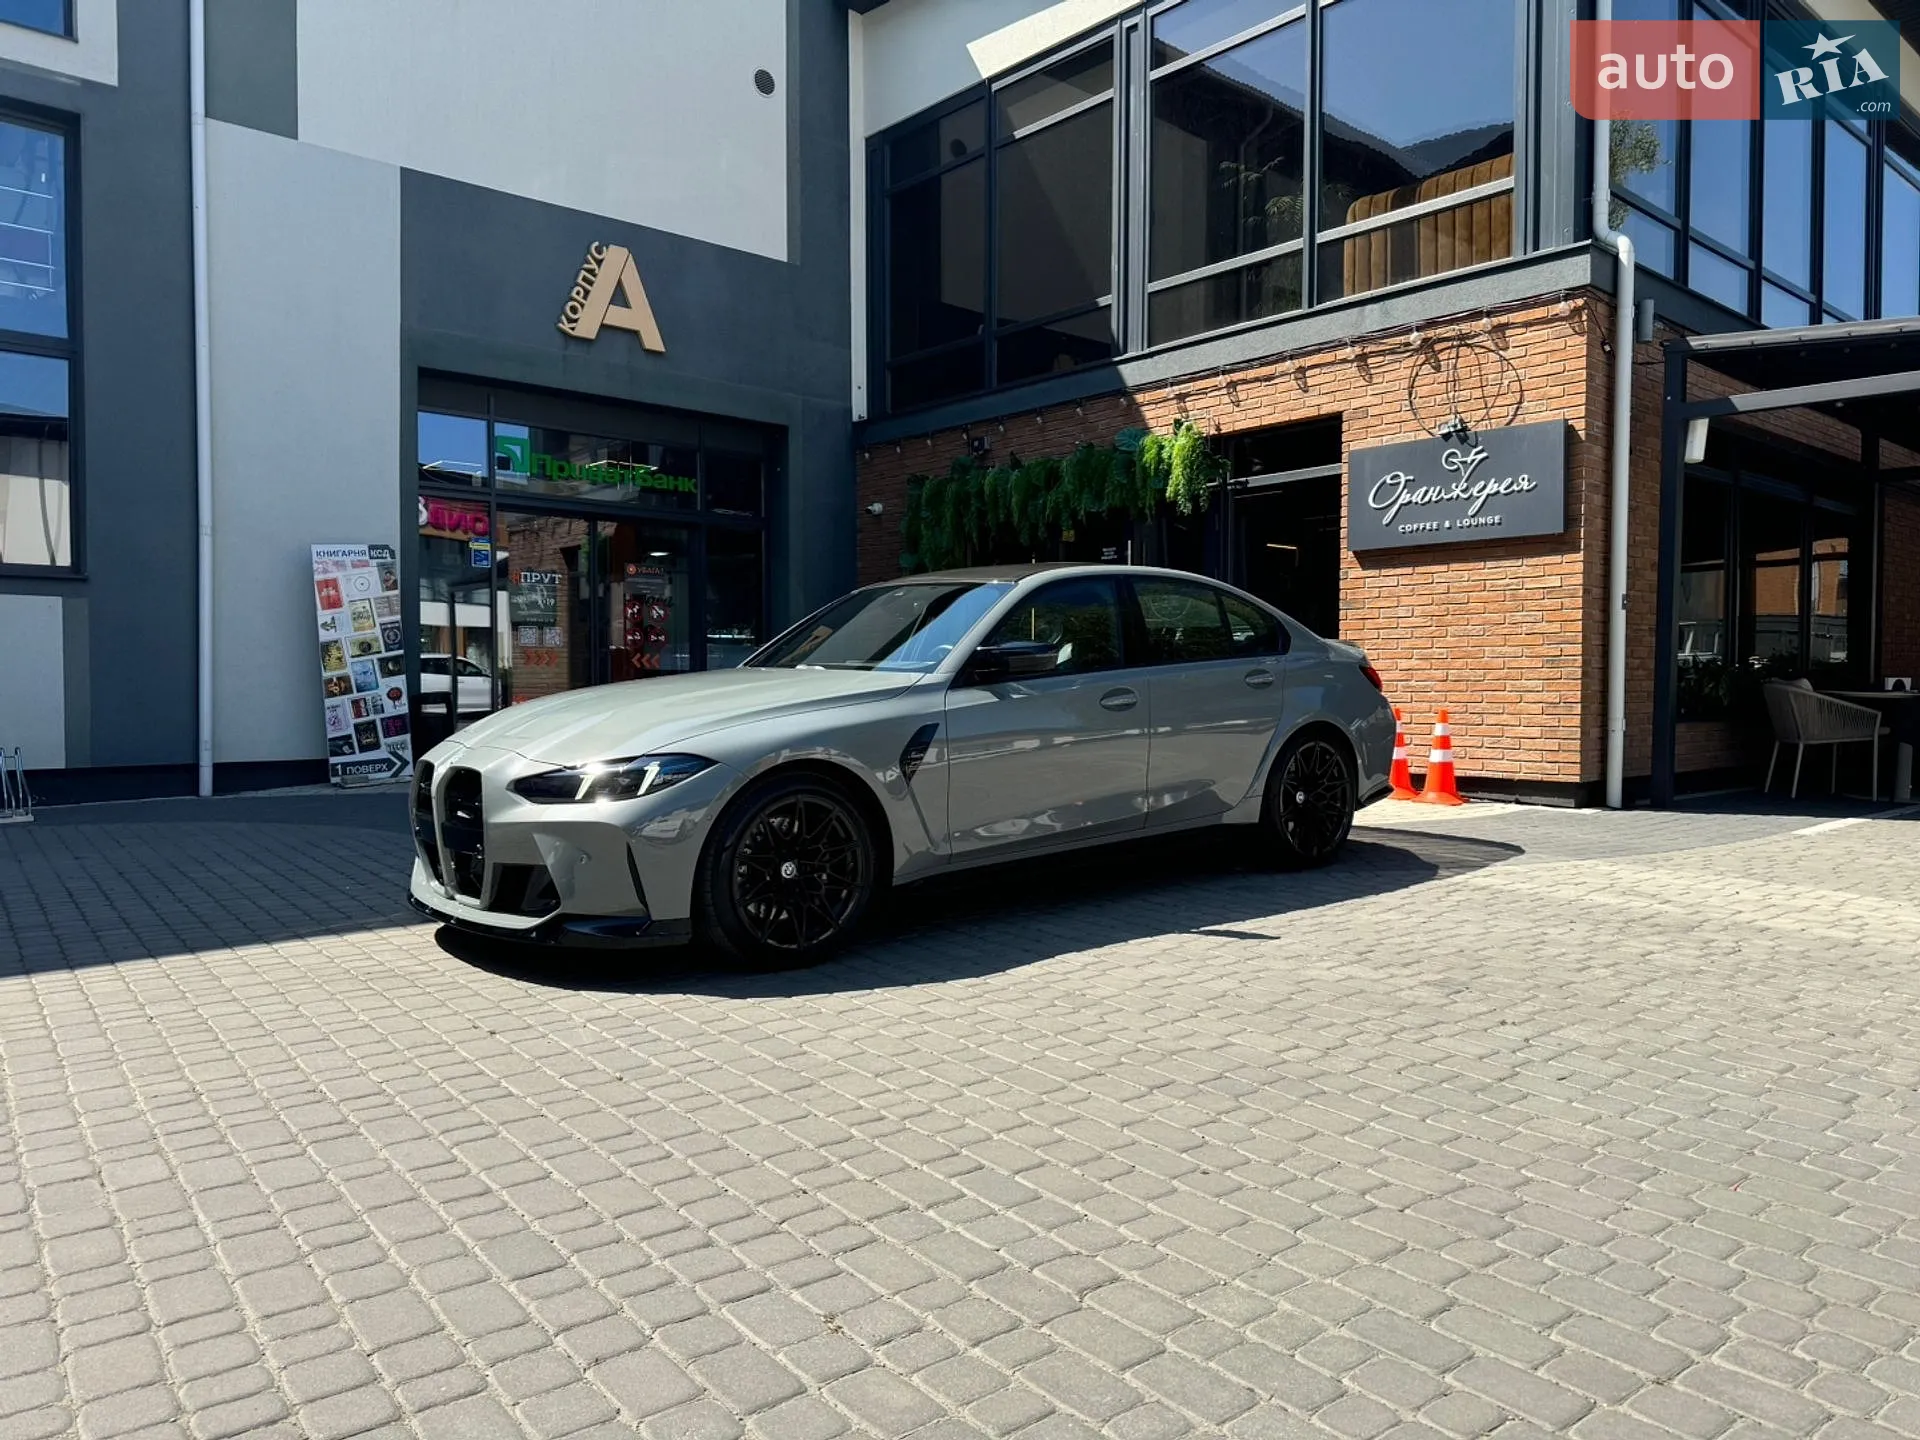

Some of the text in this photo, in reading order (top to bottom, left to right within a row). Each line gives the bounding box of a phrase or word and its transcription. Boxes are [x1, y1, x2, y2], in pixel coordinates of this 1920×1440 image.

[556, 241, 607, 336] КОРПУС
[1368, 462, 1537, 526] Оранжерея
[1398, 515, 1503, 534] COFFEE & LOUNGE
[315, 548, 367, 559] КНИГАРНЯ
[336, 762, 389, 776] 1 ПОВЕРХ
